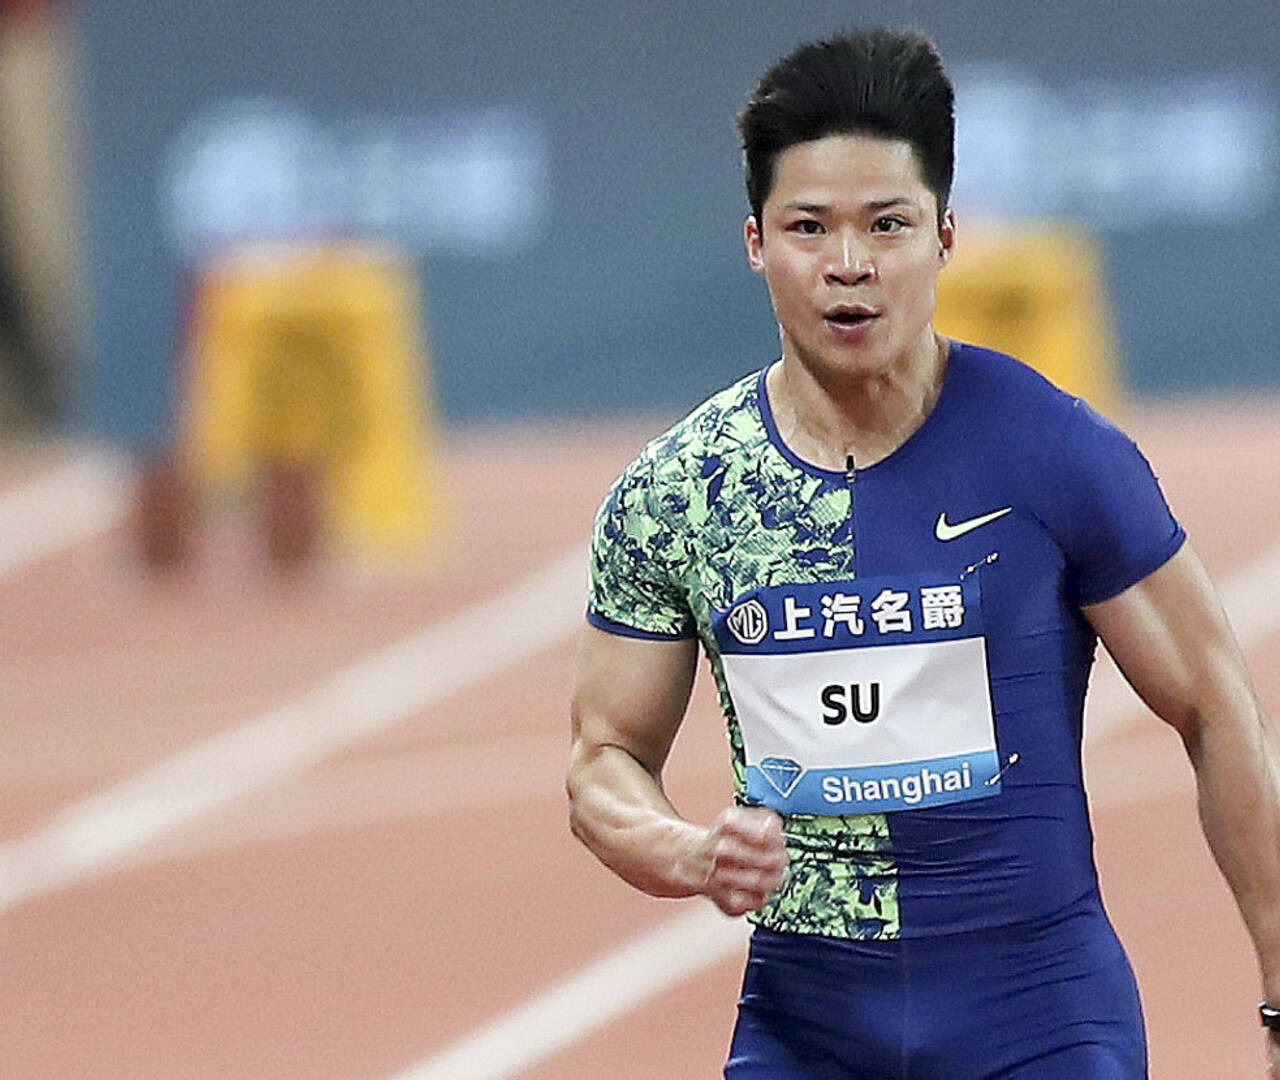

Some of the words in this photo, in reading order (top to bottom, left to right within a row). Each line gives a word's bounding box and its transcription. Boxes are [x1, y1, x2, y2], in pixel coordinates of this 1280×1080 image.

[773, 585, 965, 641] 上汽名爵
[820, 683, 880, 725] SU
[821, 763, 971, 804] Shanghai
